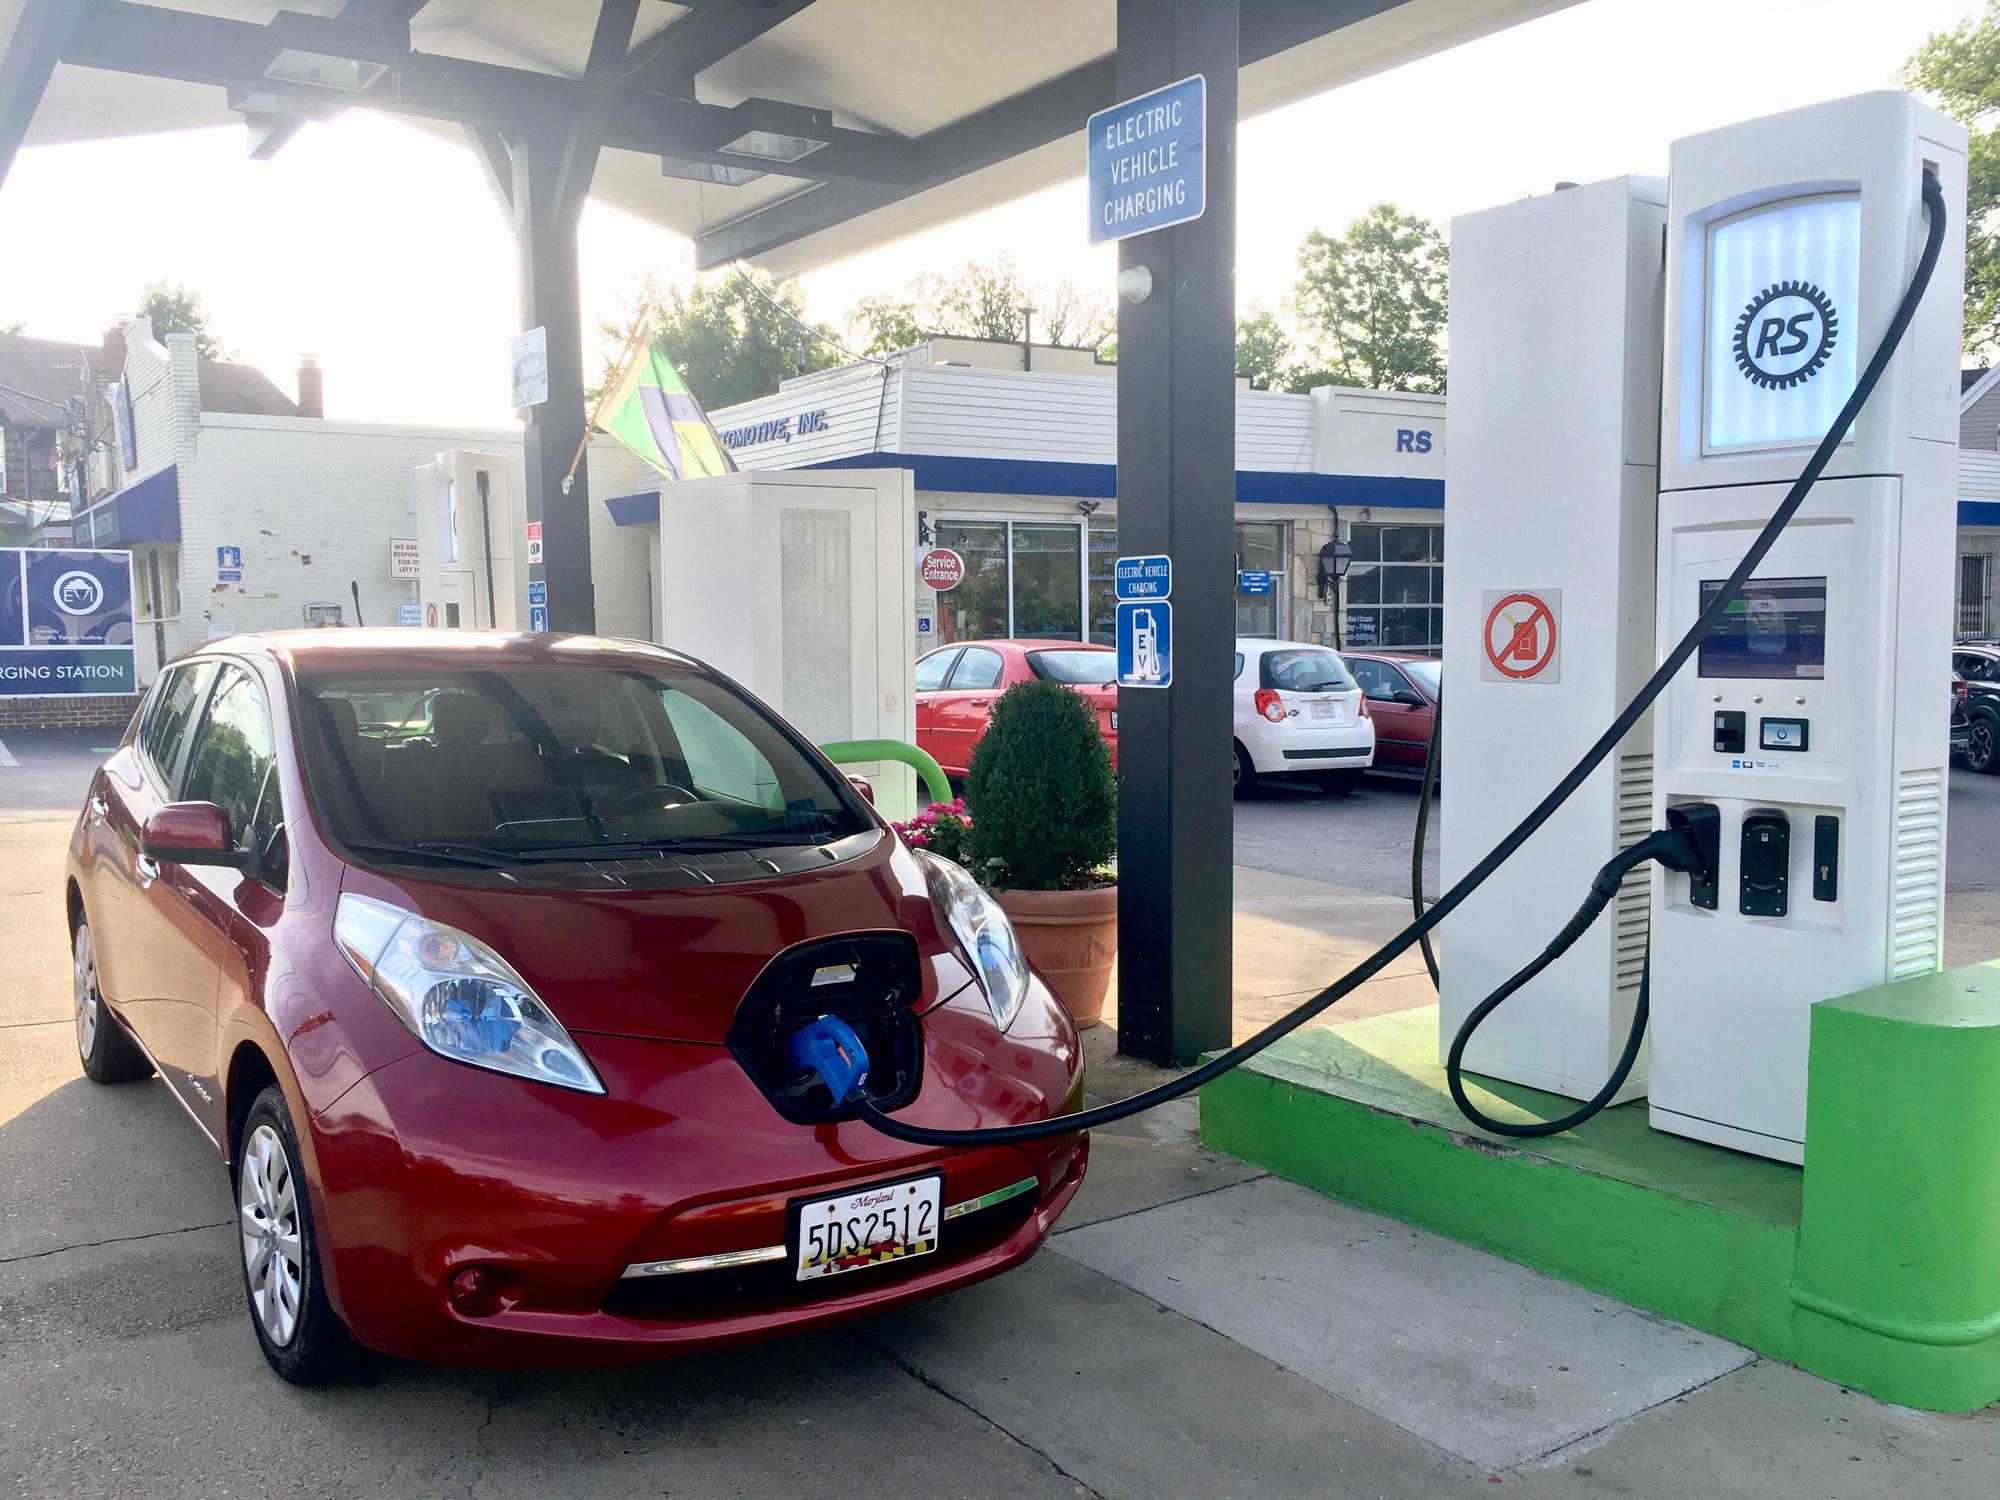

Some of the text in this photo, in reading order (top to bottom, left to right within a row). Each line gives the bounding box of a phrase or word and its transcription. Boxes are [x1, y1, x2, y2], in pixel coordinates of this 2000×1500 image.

[1106, 100, 1182, 150] ELECTRIC
[1111, 141, 1178, 186] VEHICLE
[1104, 179, 1185, 226] CHARGING
[1754, 312, 1815, 358] RS
[797, 410, 829, 435] INC.
[1396, 429, 1432, 453] RS
[926, 555, 956, 569] Service
[1118, 566, 1143, 579] ELECTRIC
[1145, 565, 1168, 577] VEHICLE
[924, 568, 959, 581] Entrance
[1128, 582, 1158, 594] CHARGING
[56, 665, 124, 679] STATION
[851, 1189, 896, 1209] Maryland
[808, 1200, 932, 1263] 5DS2512
